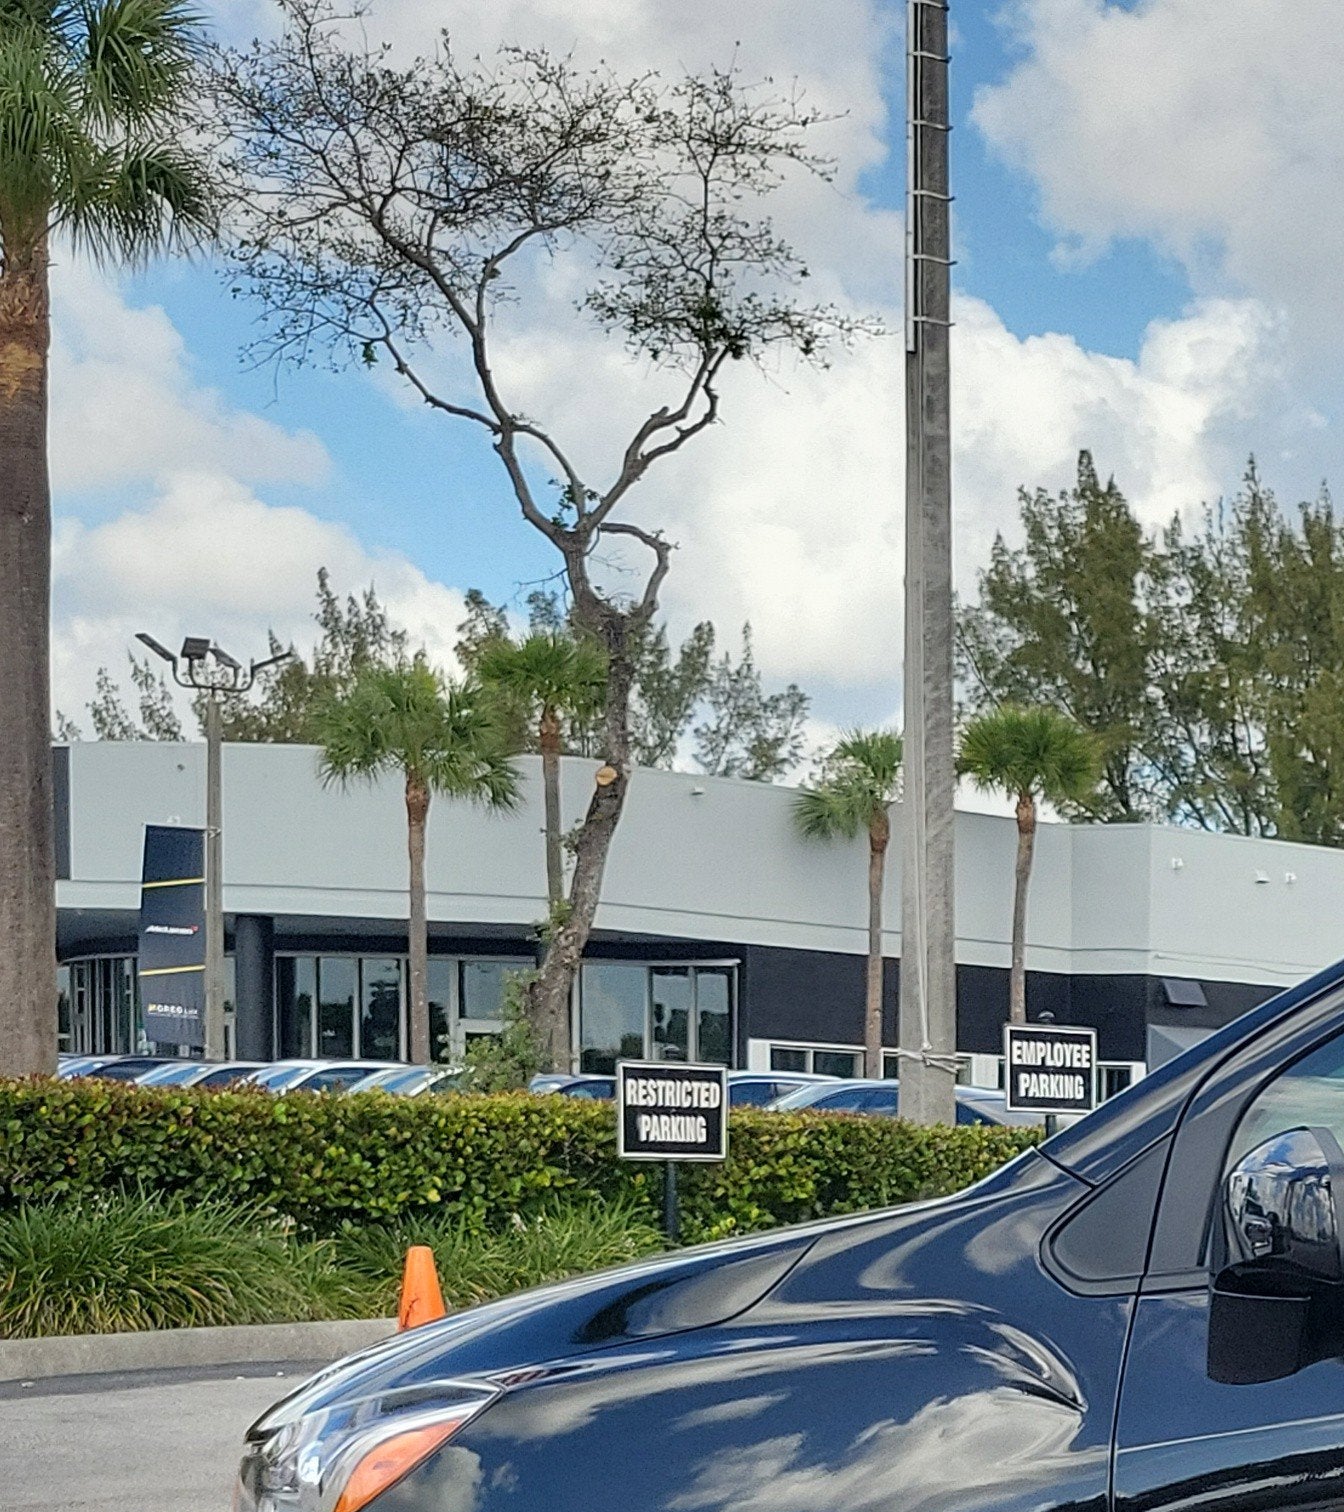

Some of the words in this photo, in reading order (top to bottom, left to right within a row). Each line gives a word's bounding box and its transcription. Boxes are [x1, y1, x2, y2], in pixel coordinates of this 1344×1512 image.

[1012, 1040, 1091, 1068] EMPLOYEE
[626, 1078, 720, 1108] RESTRICTED
[1018, 1072, 1085, 1100] PARKING
[639, 1114, 707, 1143] PARKING
